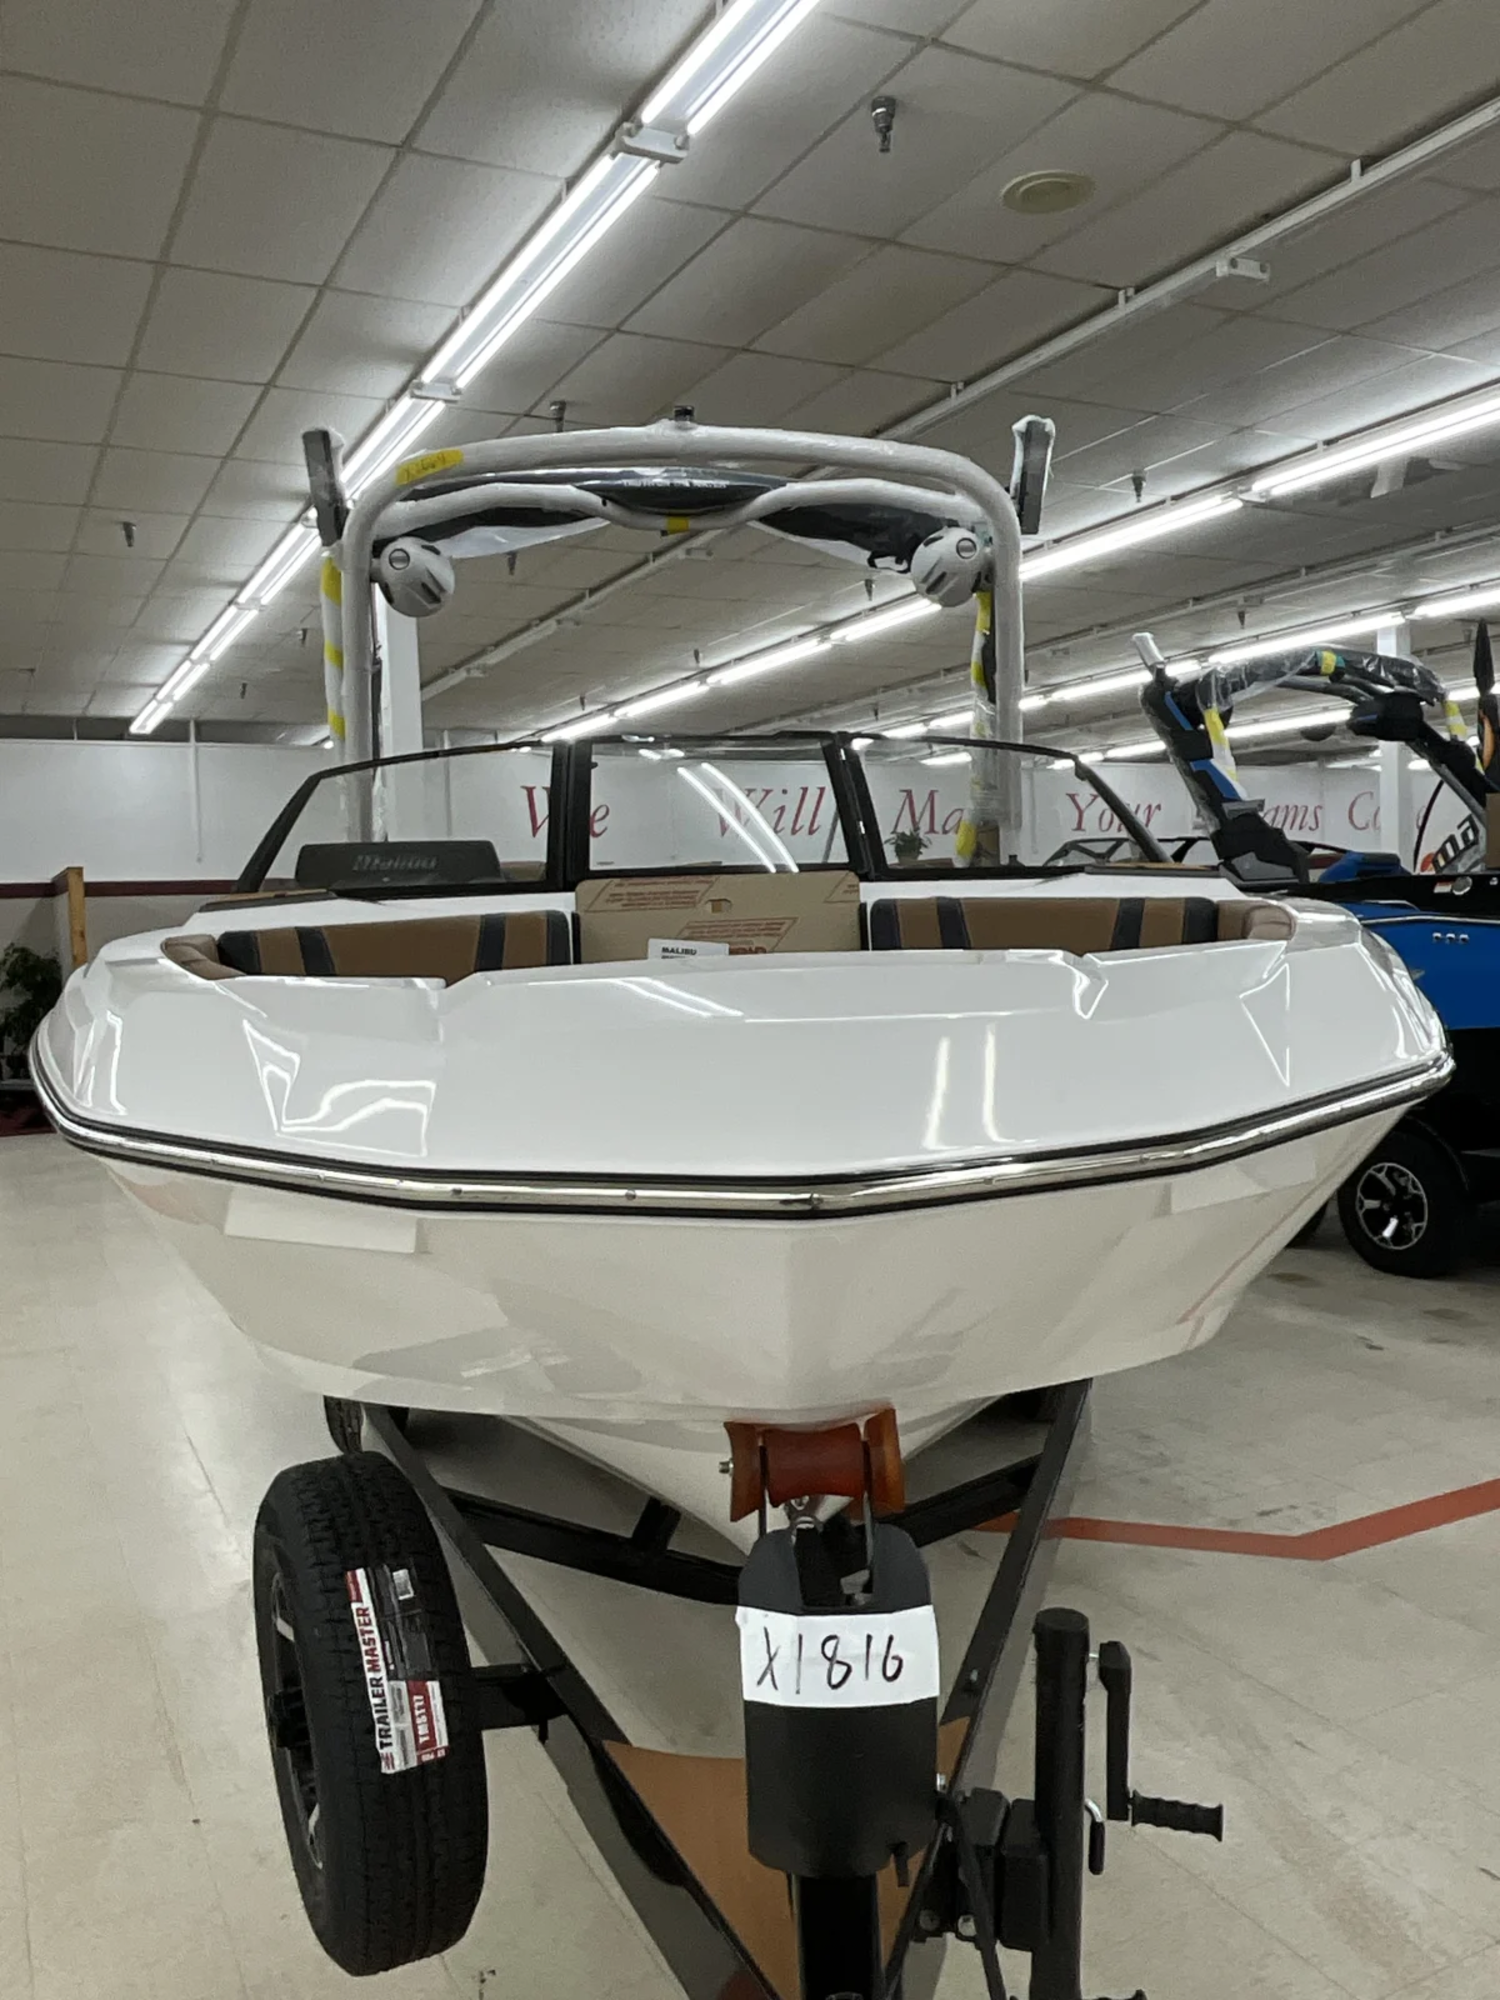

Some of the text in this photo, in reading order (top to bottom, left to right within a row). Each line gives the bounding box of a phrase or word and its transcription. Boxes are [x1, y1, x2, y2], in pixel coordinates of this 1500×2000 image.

[711, 786, 827, 837] Will
[661, 946, 697, 956] MALIBU
[355, 1606, 393, 1750] TRAILER MASTER
[756, 1626, 904, 1694] X1816
